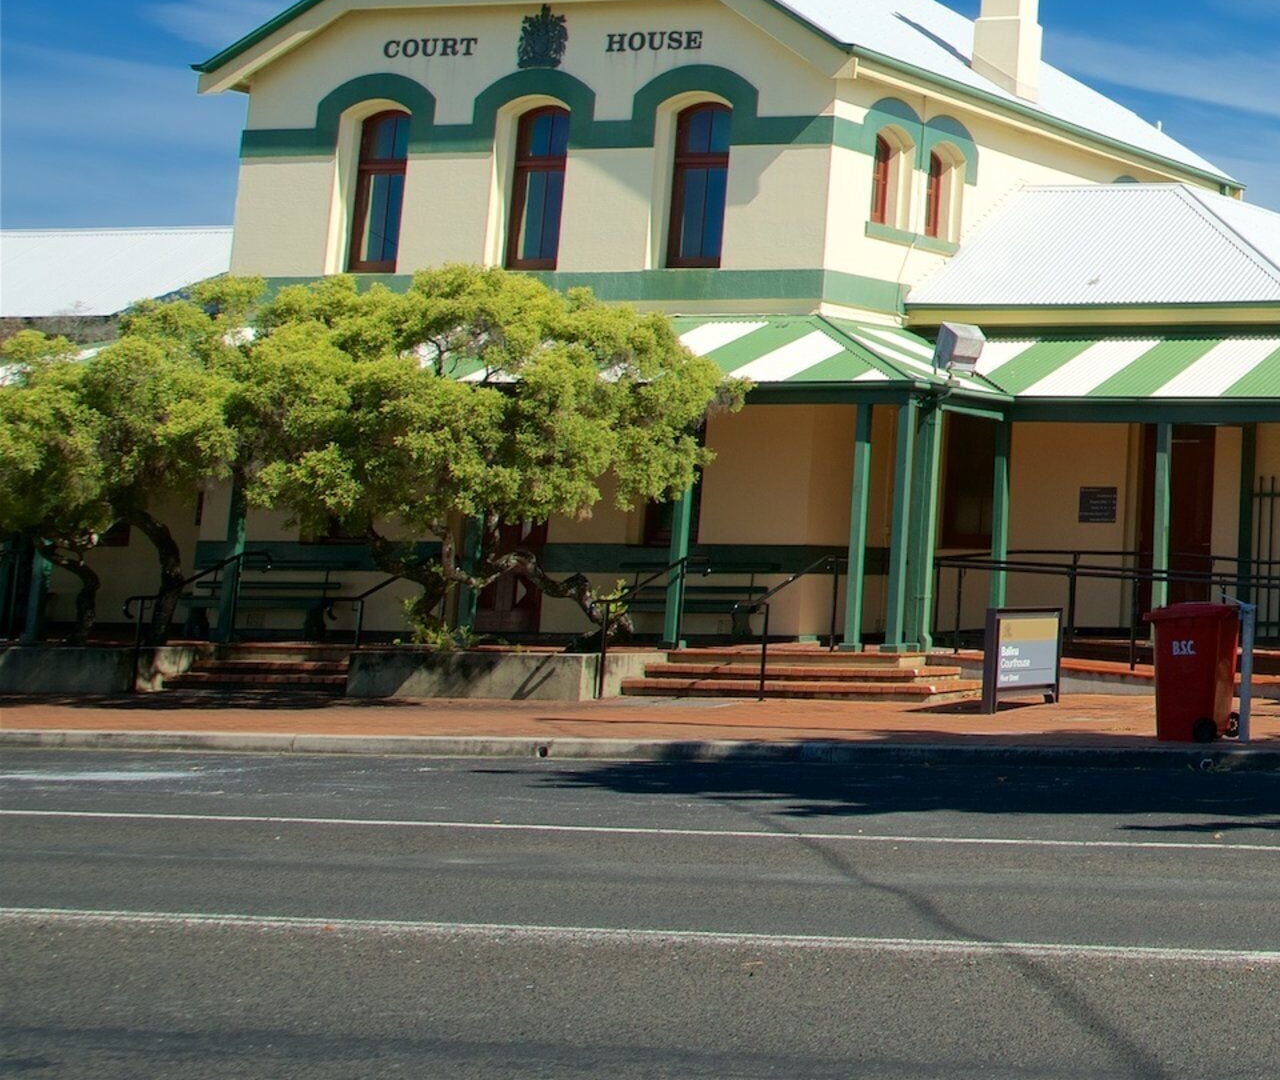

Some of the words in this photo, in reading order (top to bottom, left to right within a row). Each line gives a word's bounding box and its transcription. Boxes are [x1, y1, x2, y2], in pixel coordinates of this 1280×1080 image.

[383, 37, 478, 59] COURT
[605, 31, 703, 52] HOUSE
[1172, 640, 1196, 656] B.S.C.
